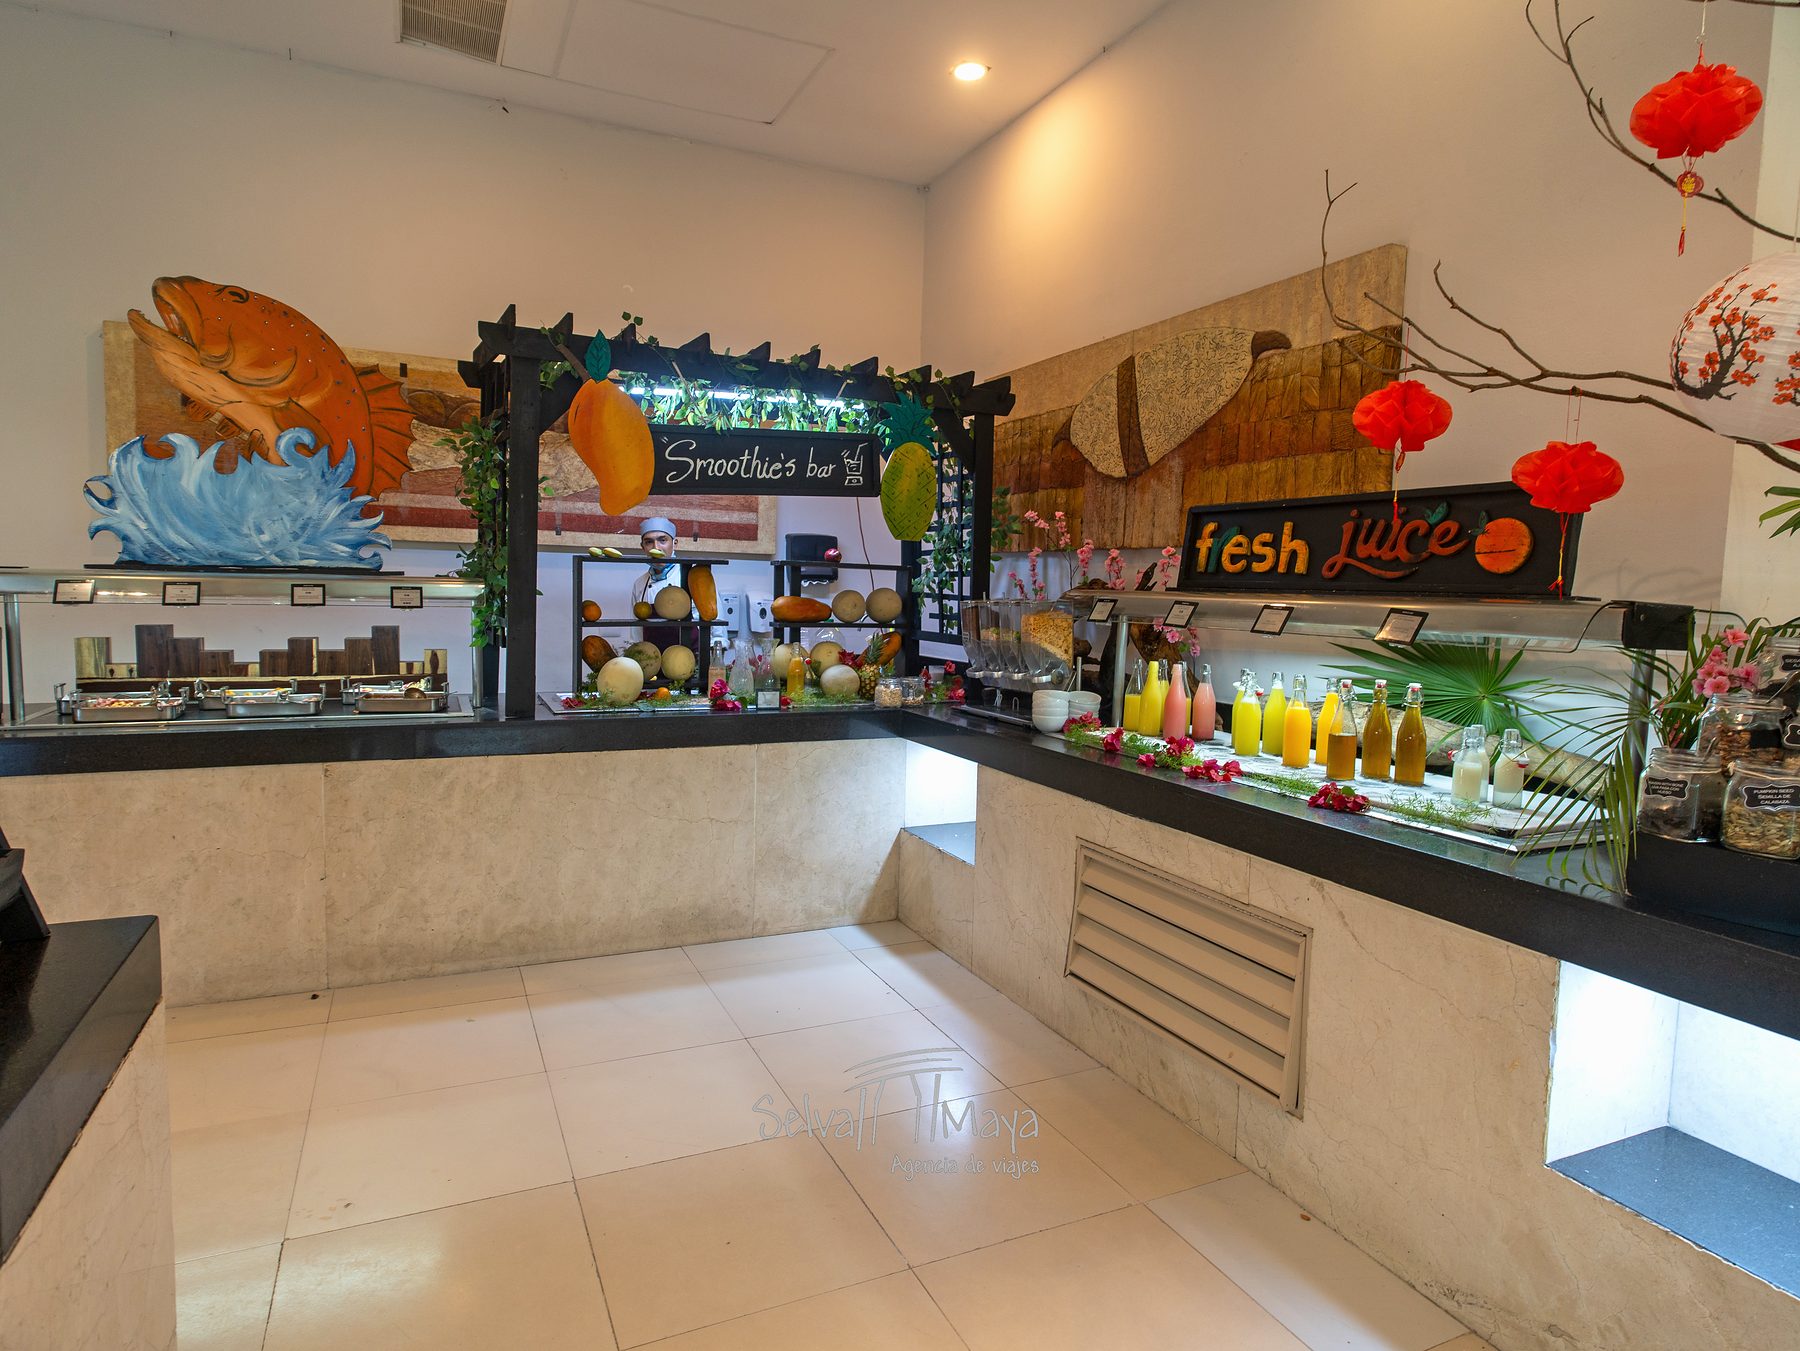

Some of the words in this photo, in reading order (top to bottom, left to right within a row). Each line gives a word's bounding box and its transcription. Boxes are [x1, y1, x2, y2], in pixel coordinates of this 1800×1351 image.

[806, 446, 836, 478] bar
[1195, 521, 1310, 575] fresh
[1320, 508, 1471, 580] juice
